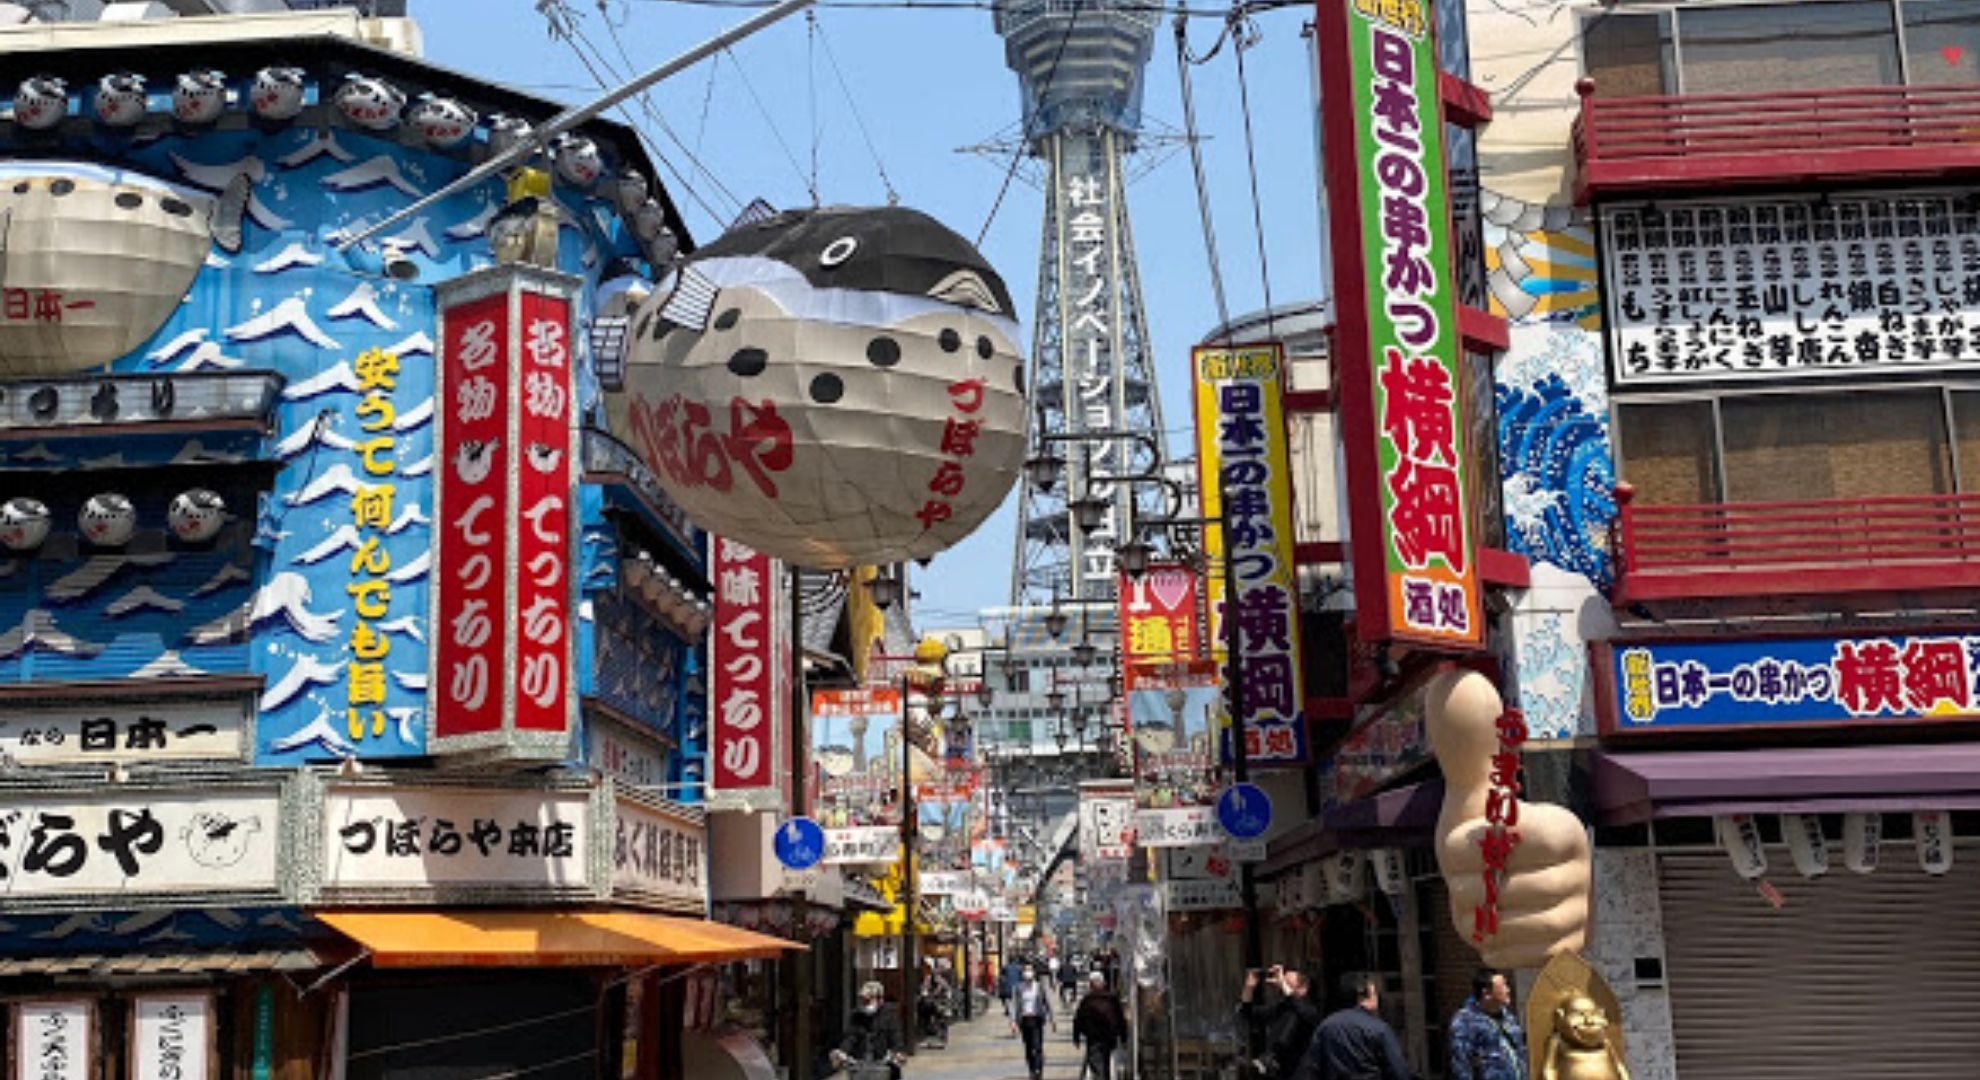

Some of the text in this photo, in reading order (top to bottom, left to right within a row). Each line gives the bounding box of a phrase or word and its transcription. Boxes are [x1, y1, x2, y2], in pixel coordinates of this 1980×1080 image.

[1373, 28, 1436, 346] 日本一の串かつ
[3, 288, 96, 323] 日本一
[1621, 290, 1651, 374] もち
[1705, 287, 1736, 370] にんにく
[1735, 285, 1764, 368] 玉ねぎ
[1763, 283, 1793, 367] 山芋
[1819, 281, 1852, 363] れんこん
[1877, 278, 1907, 361] 白ねぎ
[1380, 348, 1465, 574] 横綱
[452, 495, 495, 712] てっちり
[521, 495, 565, 709] てっちり
[1405, 578, 1468, 631] 酒処
[1656, 663, 1833, 705] 日本一の串かつ
[1835, 641, 1968, 712] 横綱
[339, 815, 575, 858] づぼらや本店
